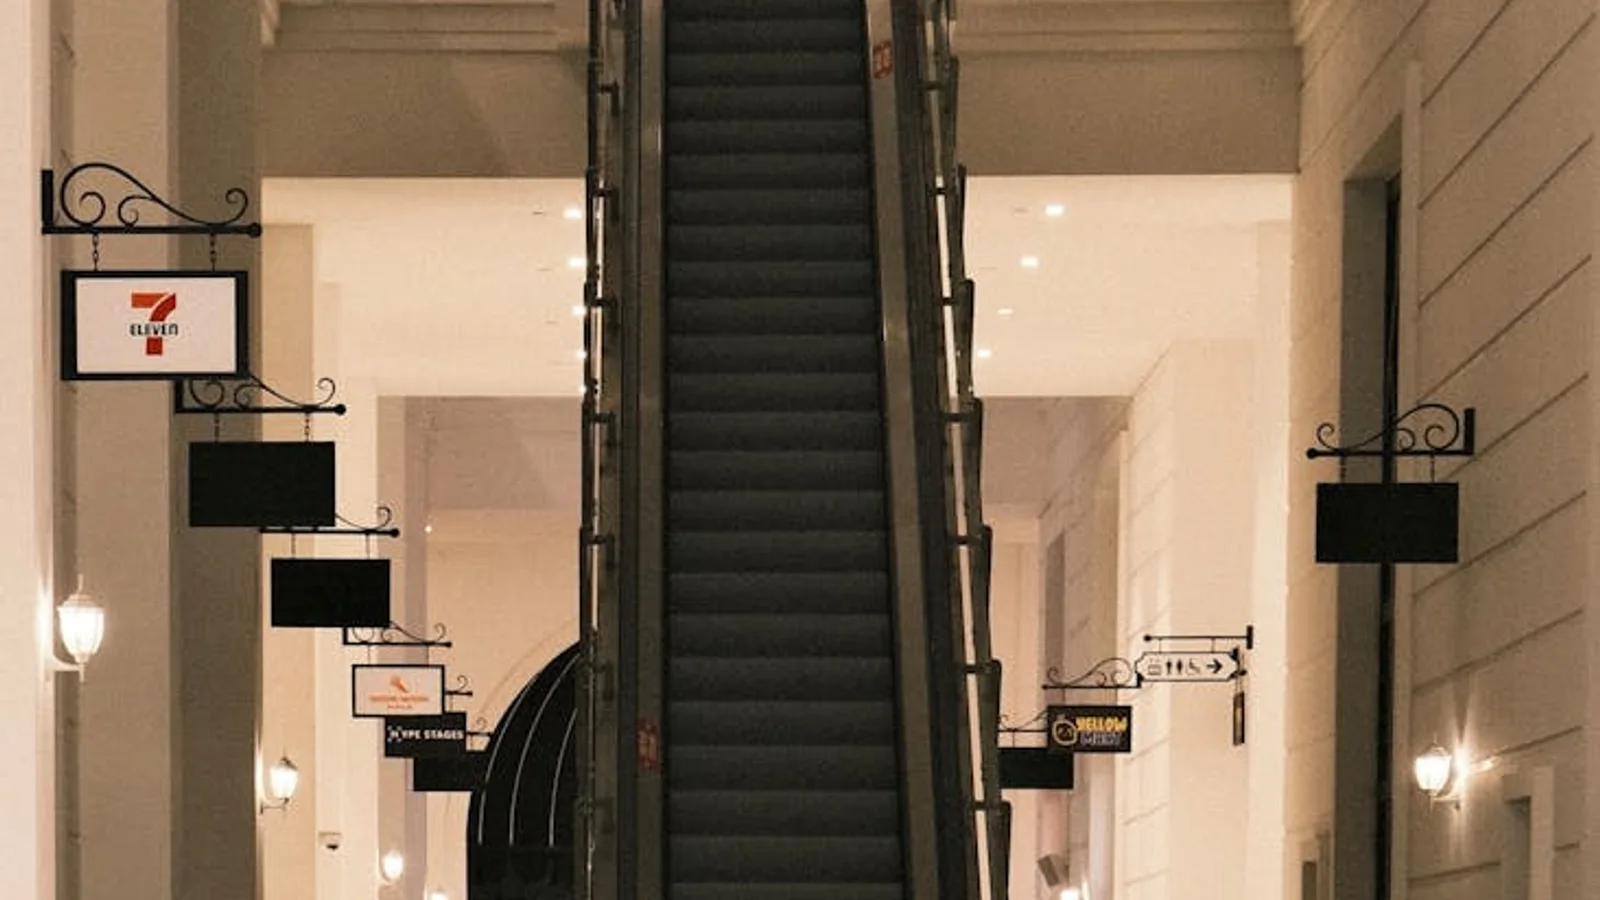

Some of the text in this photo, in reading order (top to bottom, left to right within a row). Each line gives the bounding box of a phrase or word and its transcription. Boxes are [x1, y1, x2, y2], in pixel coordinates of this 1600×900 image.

[131, 293, 176, 355] 7
[1075, 716, 1128, 732] YELLOW
[388, 728, 464, 741] HYPE STAGES
